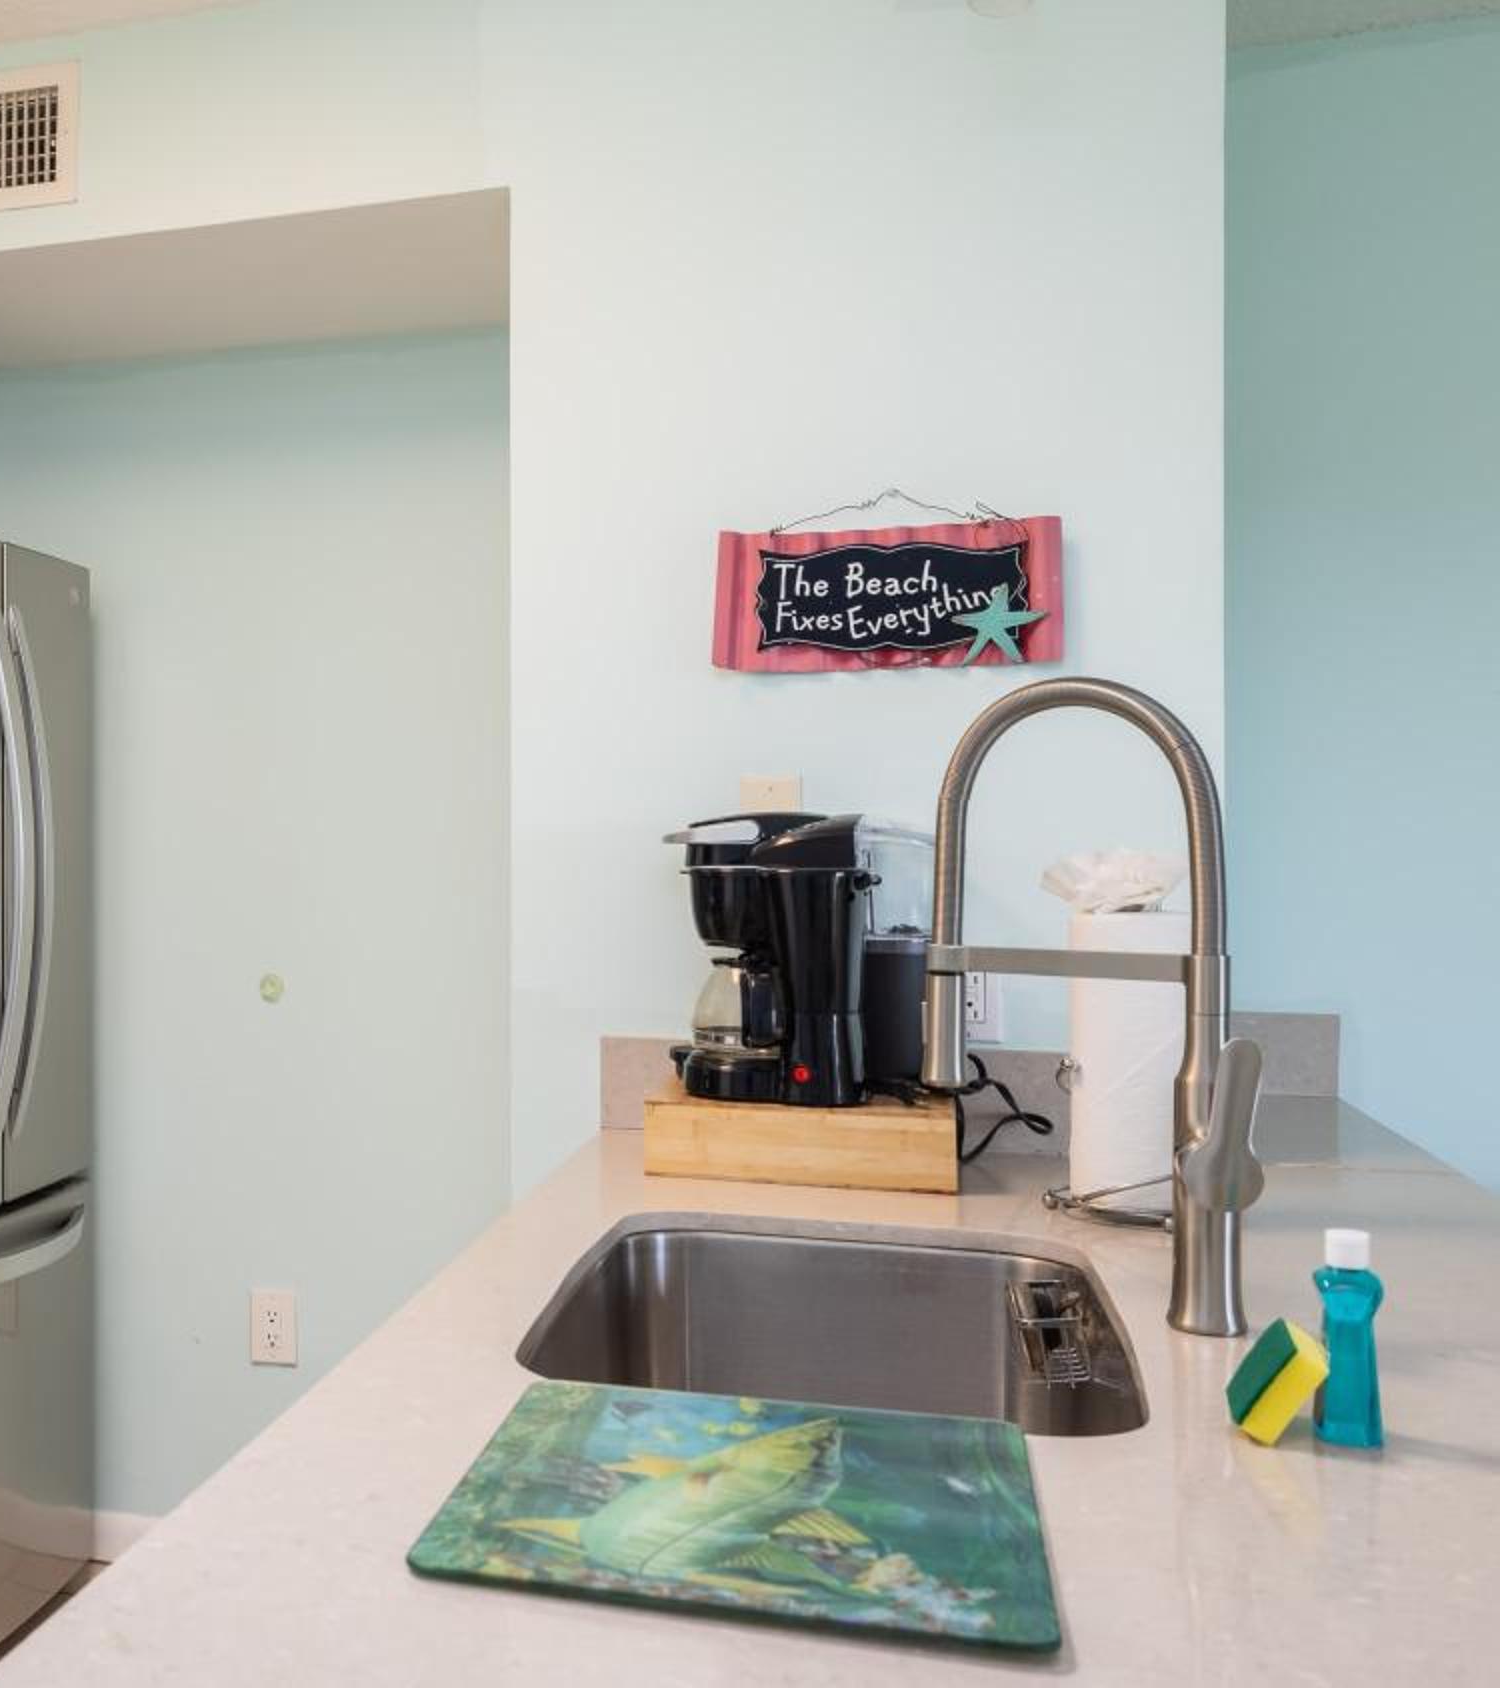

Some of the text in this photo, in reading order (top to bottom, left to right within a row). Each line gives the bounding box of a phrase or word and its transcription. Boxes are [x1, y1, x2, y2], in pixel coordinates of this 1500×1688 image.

[772, 559, 938, 600] The Beach
[774, 601, 843, 633] Fixes
